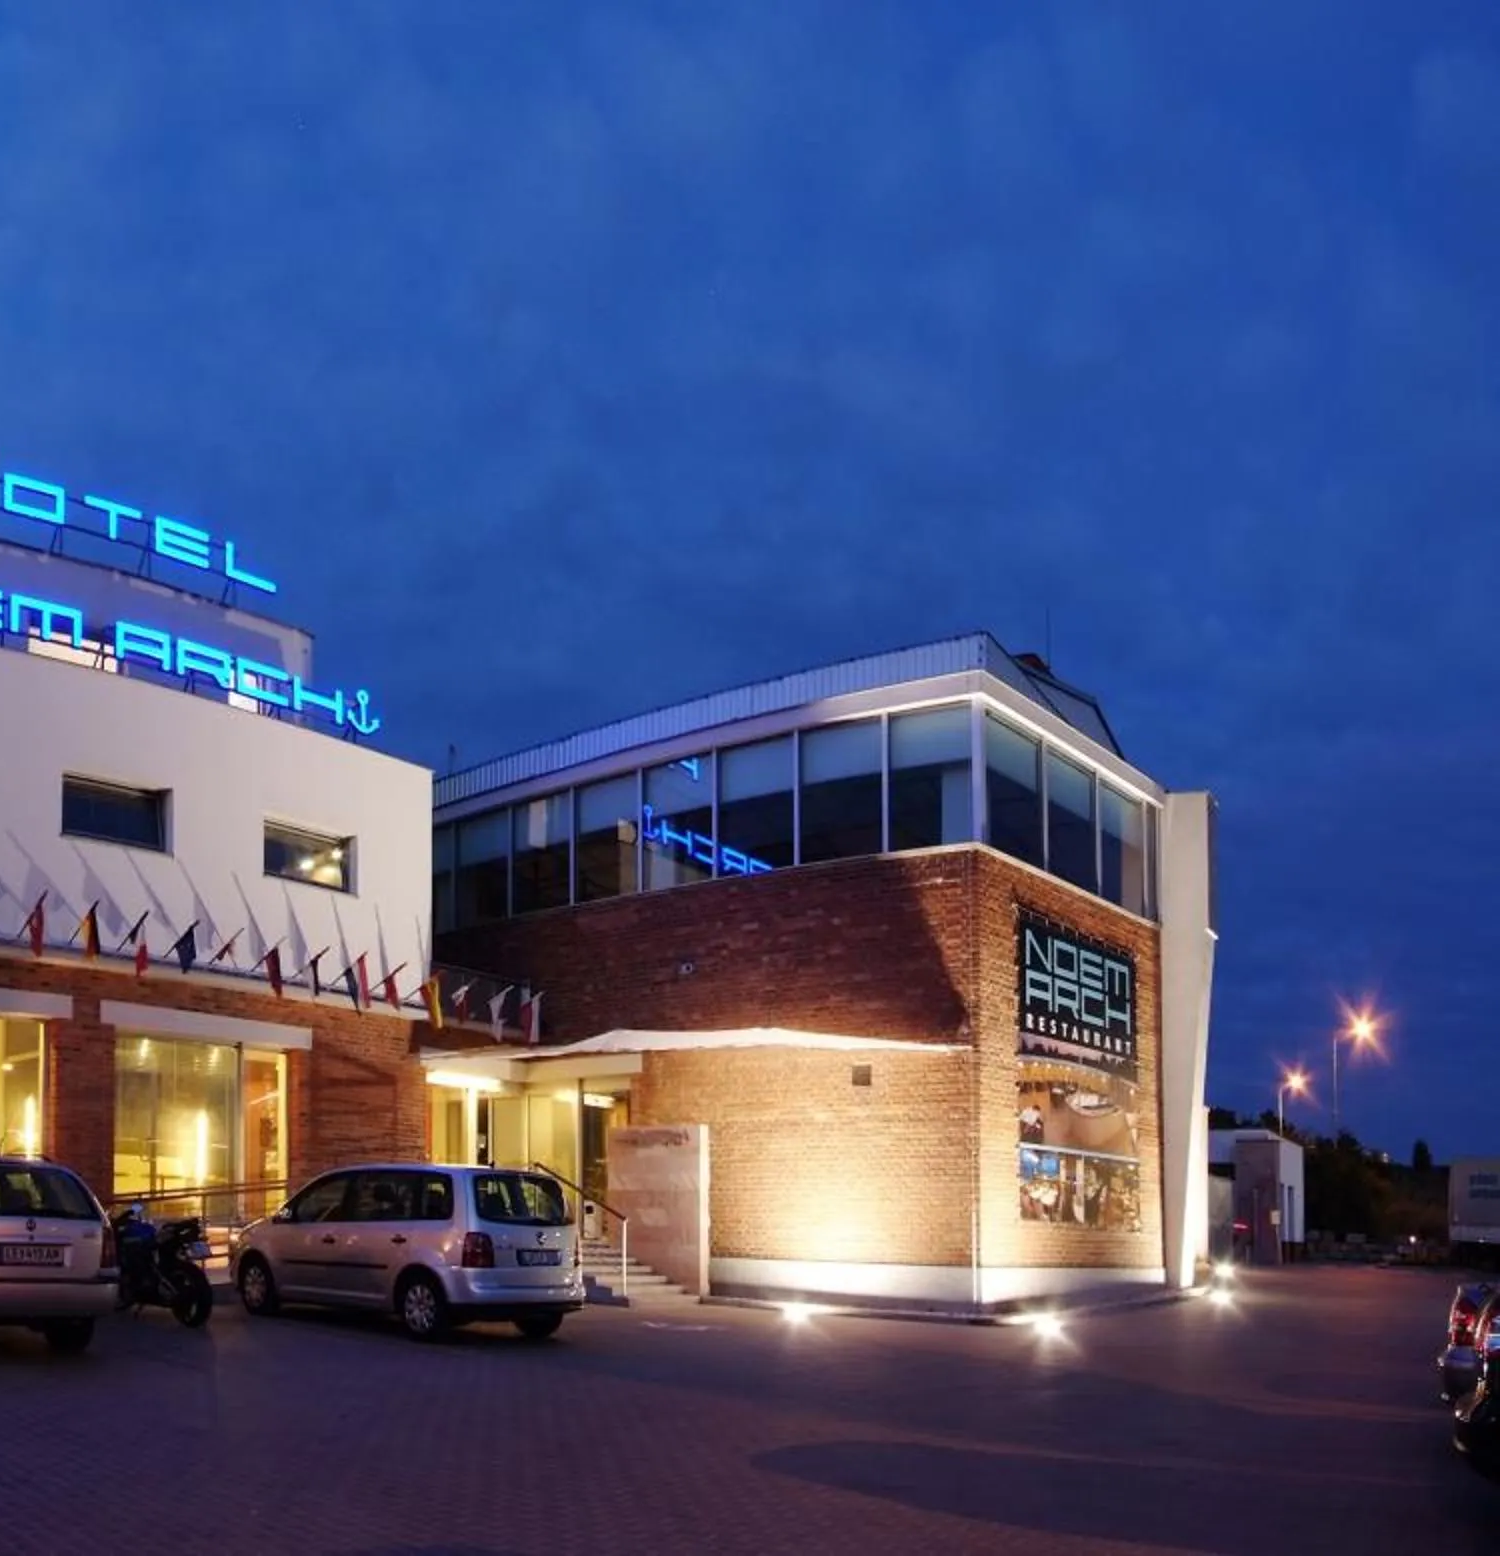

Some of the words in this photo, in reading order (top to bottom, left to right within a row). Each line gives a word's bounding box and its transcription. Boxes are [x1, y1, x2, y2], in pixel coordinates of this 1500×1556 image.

[115, 619, 346, 726] ARCH
[1025, 928, 1130, 999] NOEM
[1025, 968, 1131, 1035] ARCH
[1025, 1012, 1132, 1056] RESTAURANT
